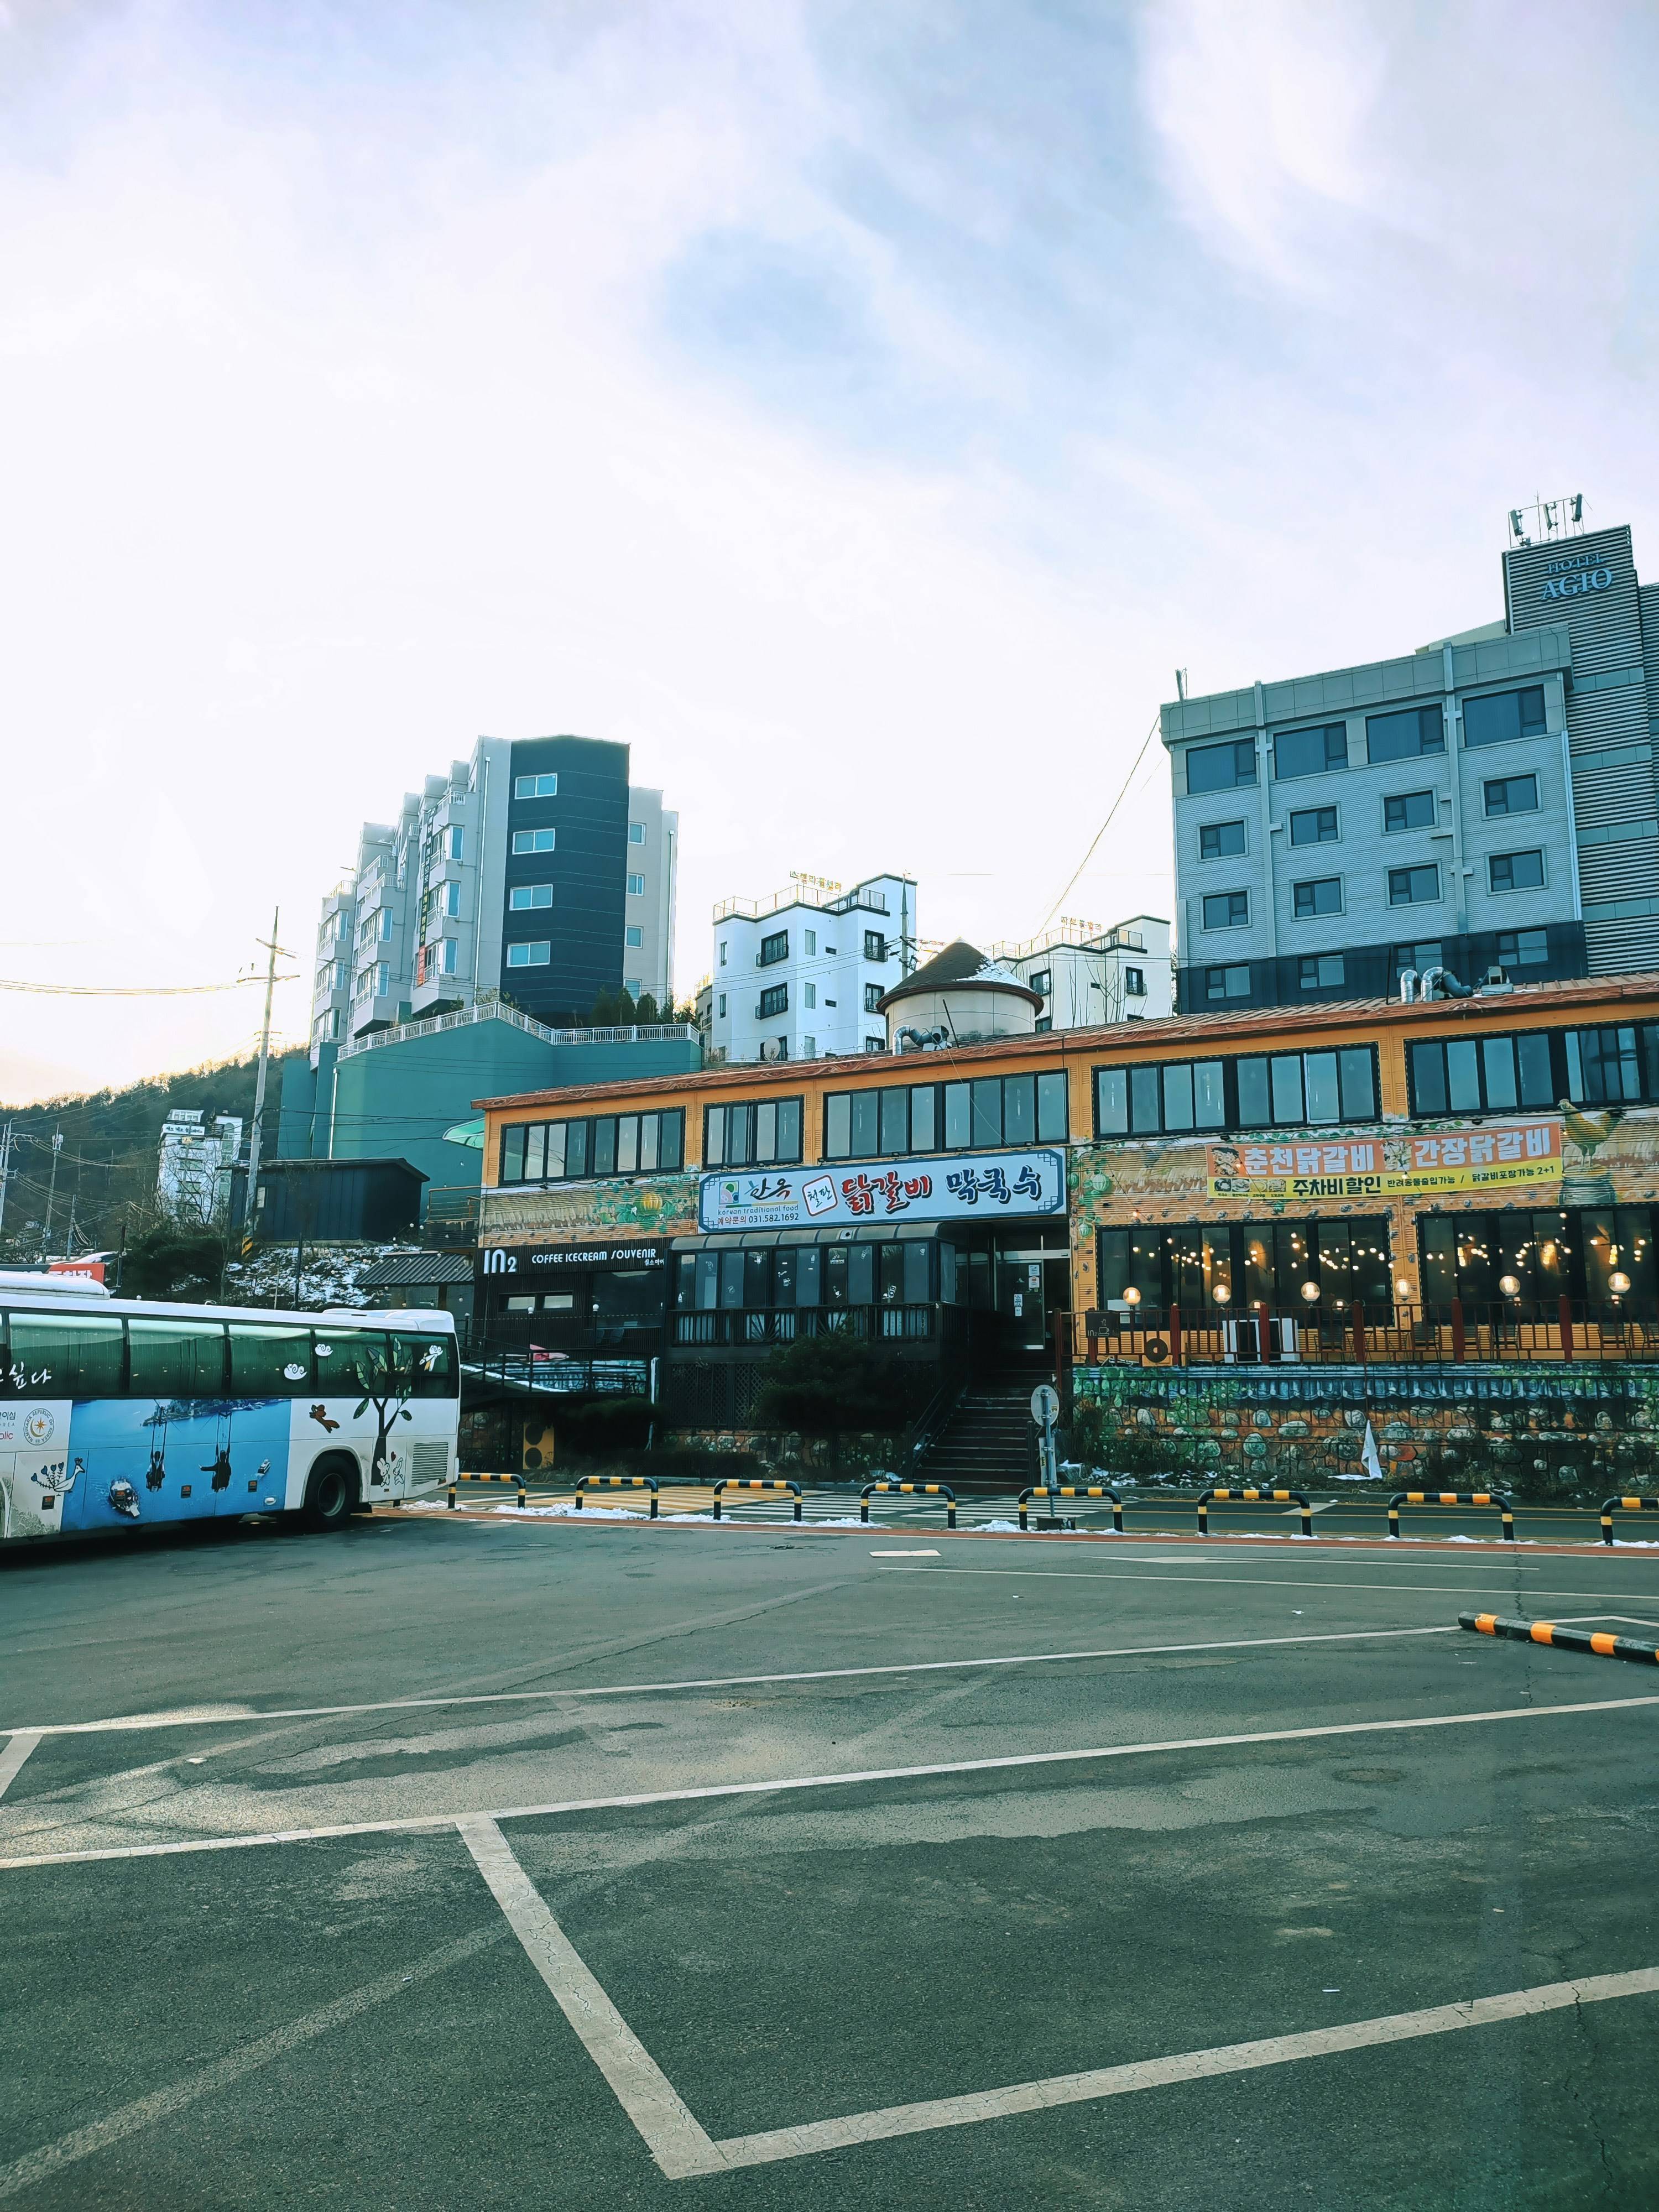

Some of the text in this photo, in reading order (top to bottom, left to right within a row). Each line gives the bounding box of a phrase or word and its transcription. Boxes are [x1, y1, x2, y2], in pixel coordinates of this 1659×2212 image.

[1548, 554, 1603, 574] HOTEL
[1541, 568, 1612, 600] AGIO
[1415, 1127, 1551, 1167] 간장닭갈비
[1244, 1144, 1374, 1175] 춘천닭갈비
[1472, 1167, 1534, 1182] 닭갈비포장가능
[1537, 1166, 1554, 1175] 2+1
[744, 1177, 793, 1201] 한옥
[807, 1185, 833, 1208] 철판
[841, 1165, 1042, 1215] 닭갈비 막국수
[1292, 1176, 1381, 1197] 주차비 할인
[717, 1213, 799, 1225] 예약문의 031.582.1692
[531, 1248, 656, 1264] COFFEE ICECREAM SOUVENIR
[9, 1361, 52, 1390] 싶다
[0, 1411, 16, 1420] 이섬
